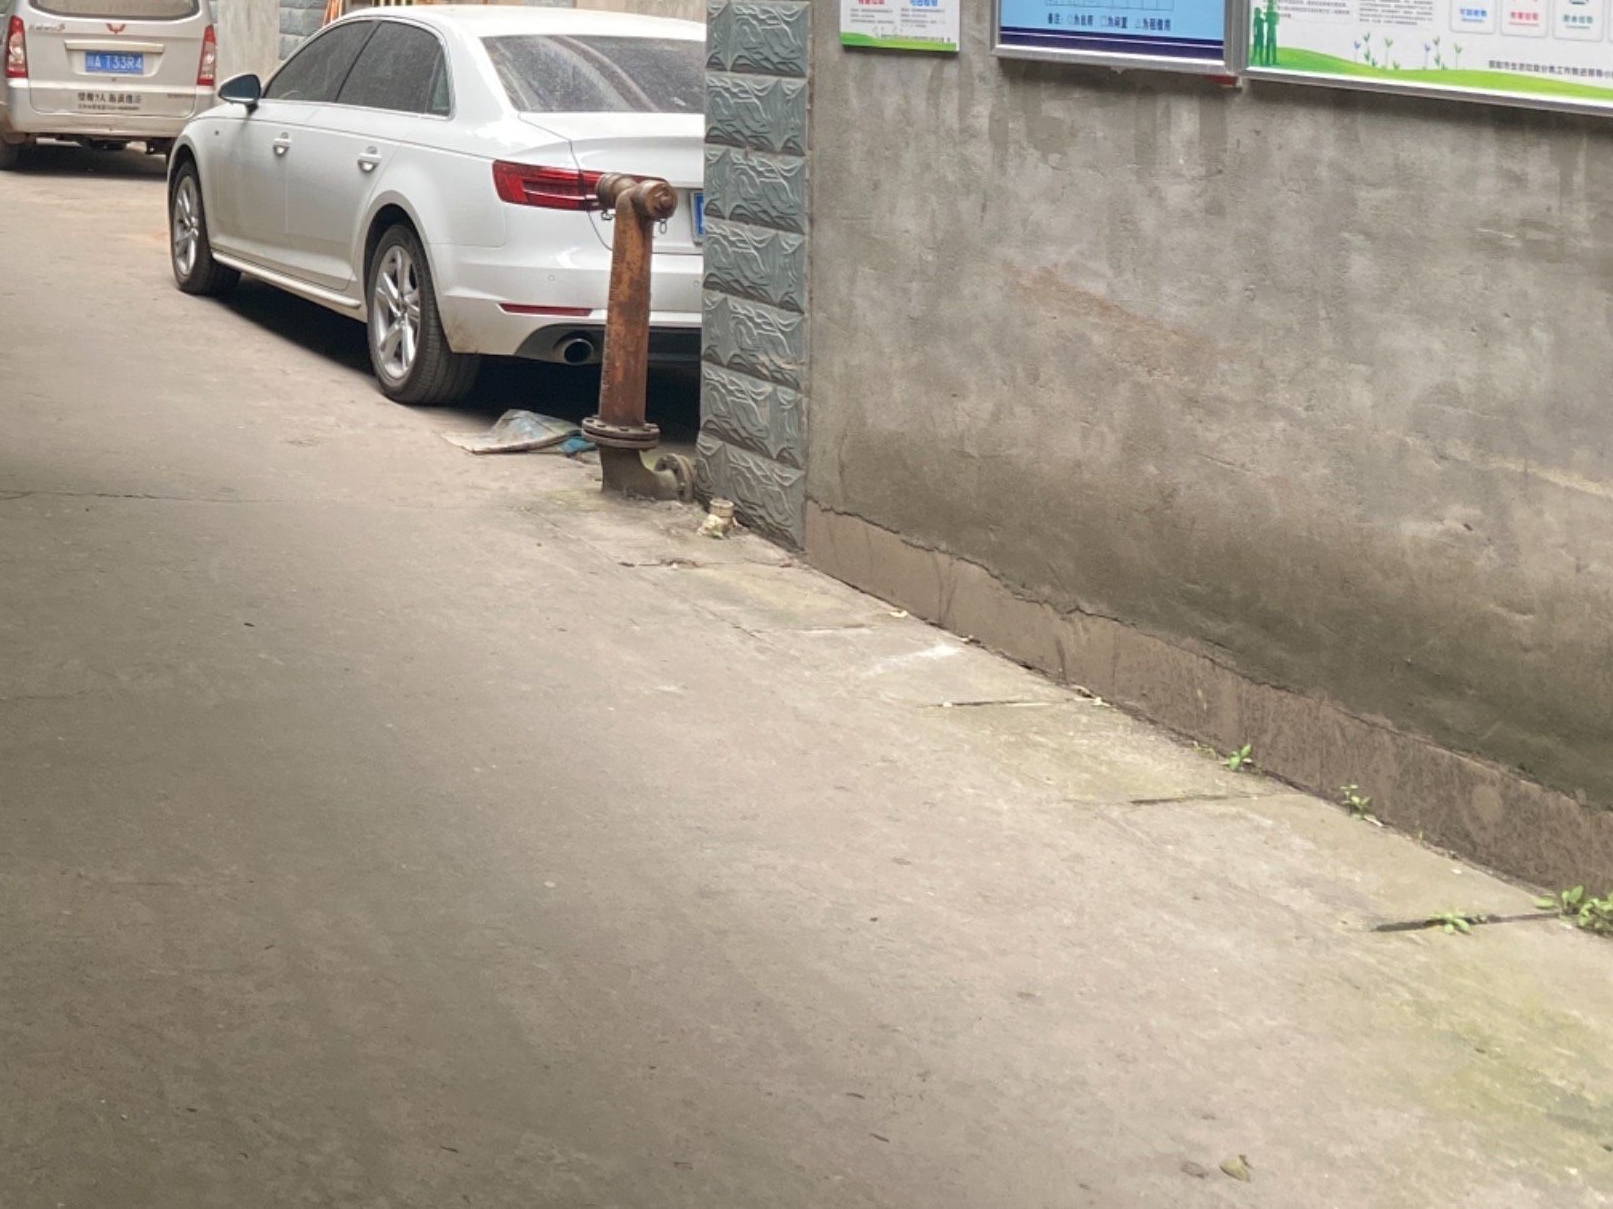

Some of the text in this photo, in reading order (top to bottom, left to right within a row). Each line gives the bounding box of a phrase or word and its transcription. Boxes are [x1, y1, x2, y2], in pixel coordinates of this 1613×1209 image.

[1489, 59, 1613, 79] 简阳市生活垃圾分类工作推进领导小
